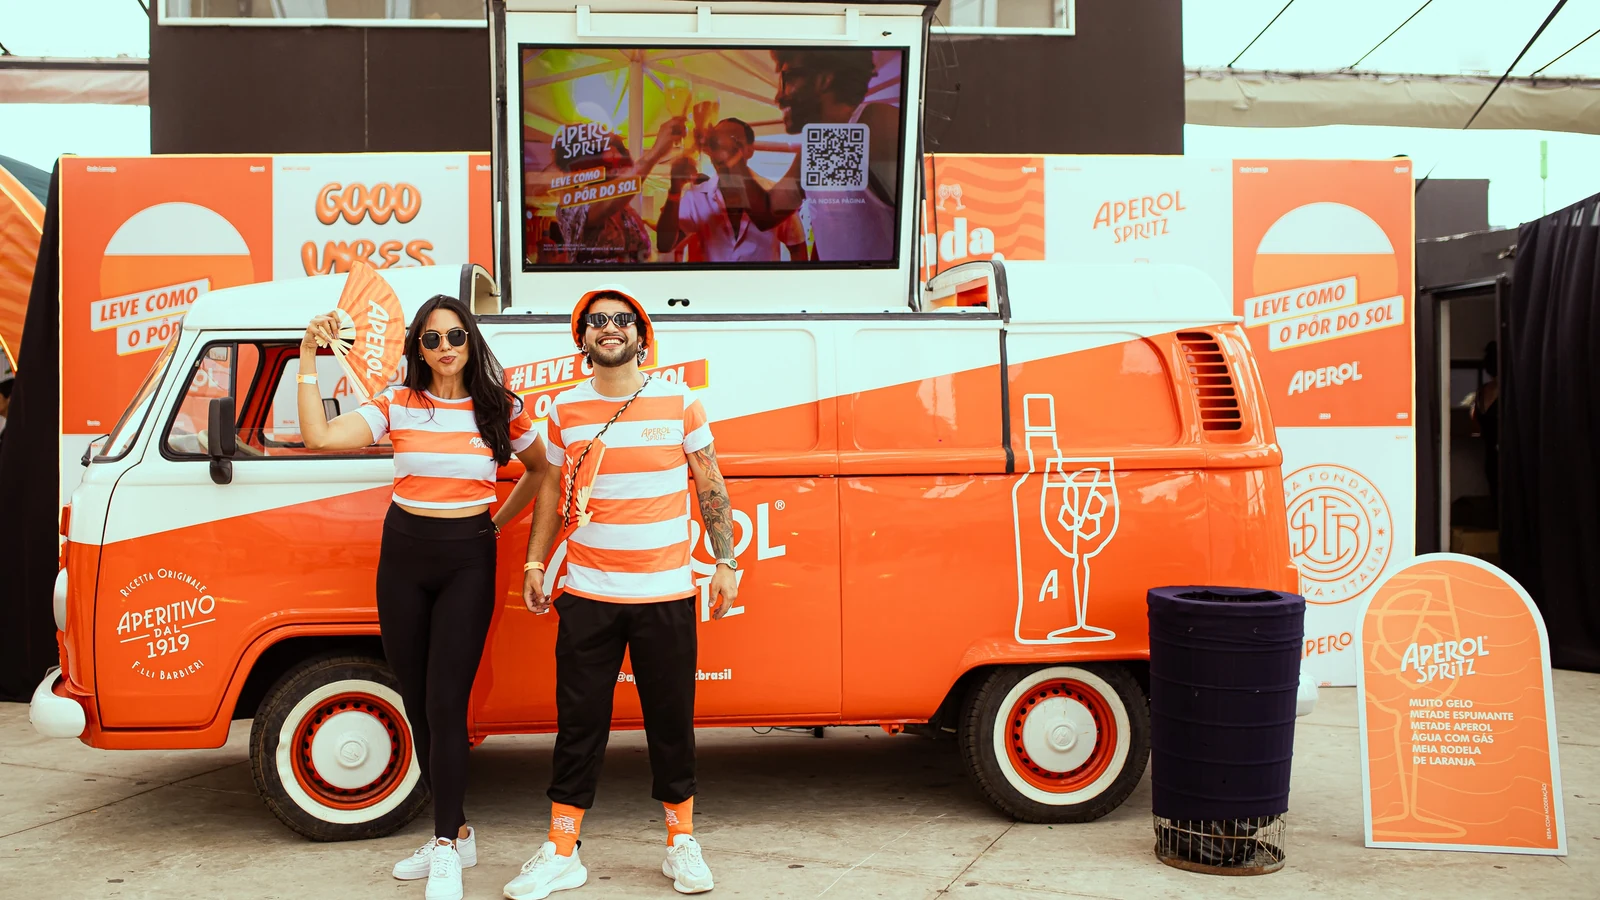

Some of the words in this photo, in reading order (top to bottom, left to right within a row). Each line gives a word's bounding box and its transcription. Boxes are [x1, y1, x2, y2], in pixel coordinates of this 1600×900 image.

[551, 122, 622, 149] APEROL
[551, 175, 571, 188] LEVE
[573, 169, 600, 183] COMO
[563, 193, 572, 204] O
[574, 187, 597, 203] PÔR
[600, 184, 615, 197] DO
[618, 180, 637, 193] SOL
[315, 182, 422, 225] GOOD
[1092, 190, 1186, 229] APEROL
[1114, 218, 1170, 244] SPRITZ
[100, 298, 139, 321] LEVE
[145, 287, 198, 312] COMO
[1253, 296, 1291, 318] LEVE
[1296, 285, 1346, 309] COMO
[1279, 326, 1292, 343] O
[1297, 315, 1331, 340] PÔR
[1336, 312, 1359, 331] DO
[1365, 304, 1393, 326] SOL
[128, 330, 140, 347] O
[363, 299, 390, 379] APEROL
[510, 356, 576, 391] #LEVE
[1287, 361, 1362, 396] APEROL
[641, 427, 670, 437] APEROL
[1308, 471, 1381, 517] FONDATA
[120, 572, 154, 597] RICETTA
[157, 568, 207, 593] ORIGINALE
[1342, 546, 1384, 593] ITALIA
[1038, 569, 1059, 602] A
[116, 595, 215, 635] APERITIVO
[154, 624, 180, 638] DAL
[146, 633, 190, 658] 1919
[1400, 636, 1489, 672] APEROL
[160, 659, 204, 680] BARBIERI
[1409, 699, 1443, 708] MUITO
[1446, 699, 1473, 708] GELO
[1410, 710, 1450, 719] METADE
[1453, 711, 1514, 721] ESPUMANTE
[1410, 721, 1451, 731] METADE
[1453, 723, 1493, 732] APEROL
[1411, 731, 1442, 742] ÁGUA
[1444, 734, 1470, 743] COM
[1472, 733, 1494, 744] GÁS
[1412, 744, 1438, 754] MEIA
[1440, 745, 1482, 755] RODELA
[1412, 756, 1427, 765] DE
[1429, 756, 1476, 766] LARANJA
